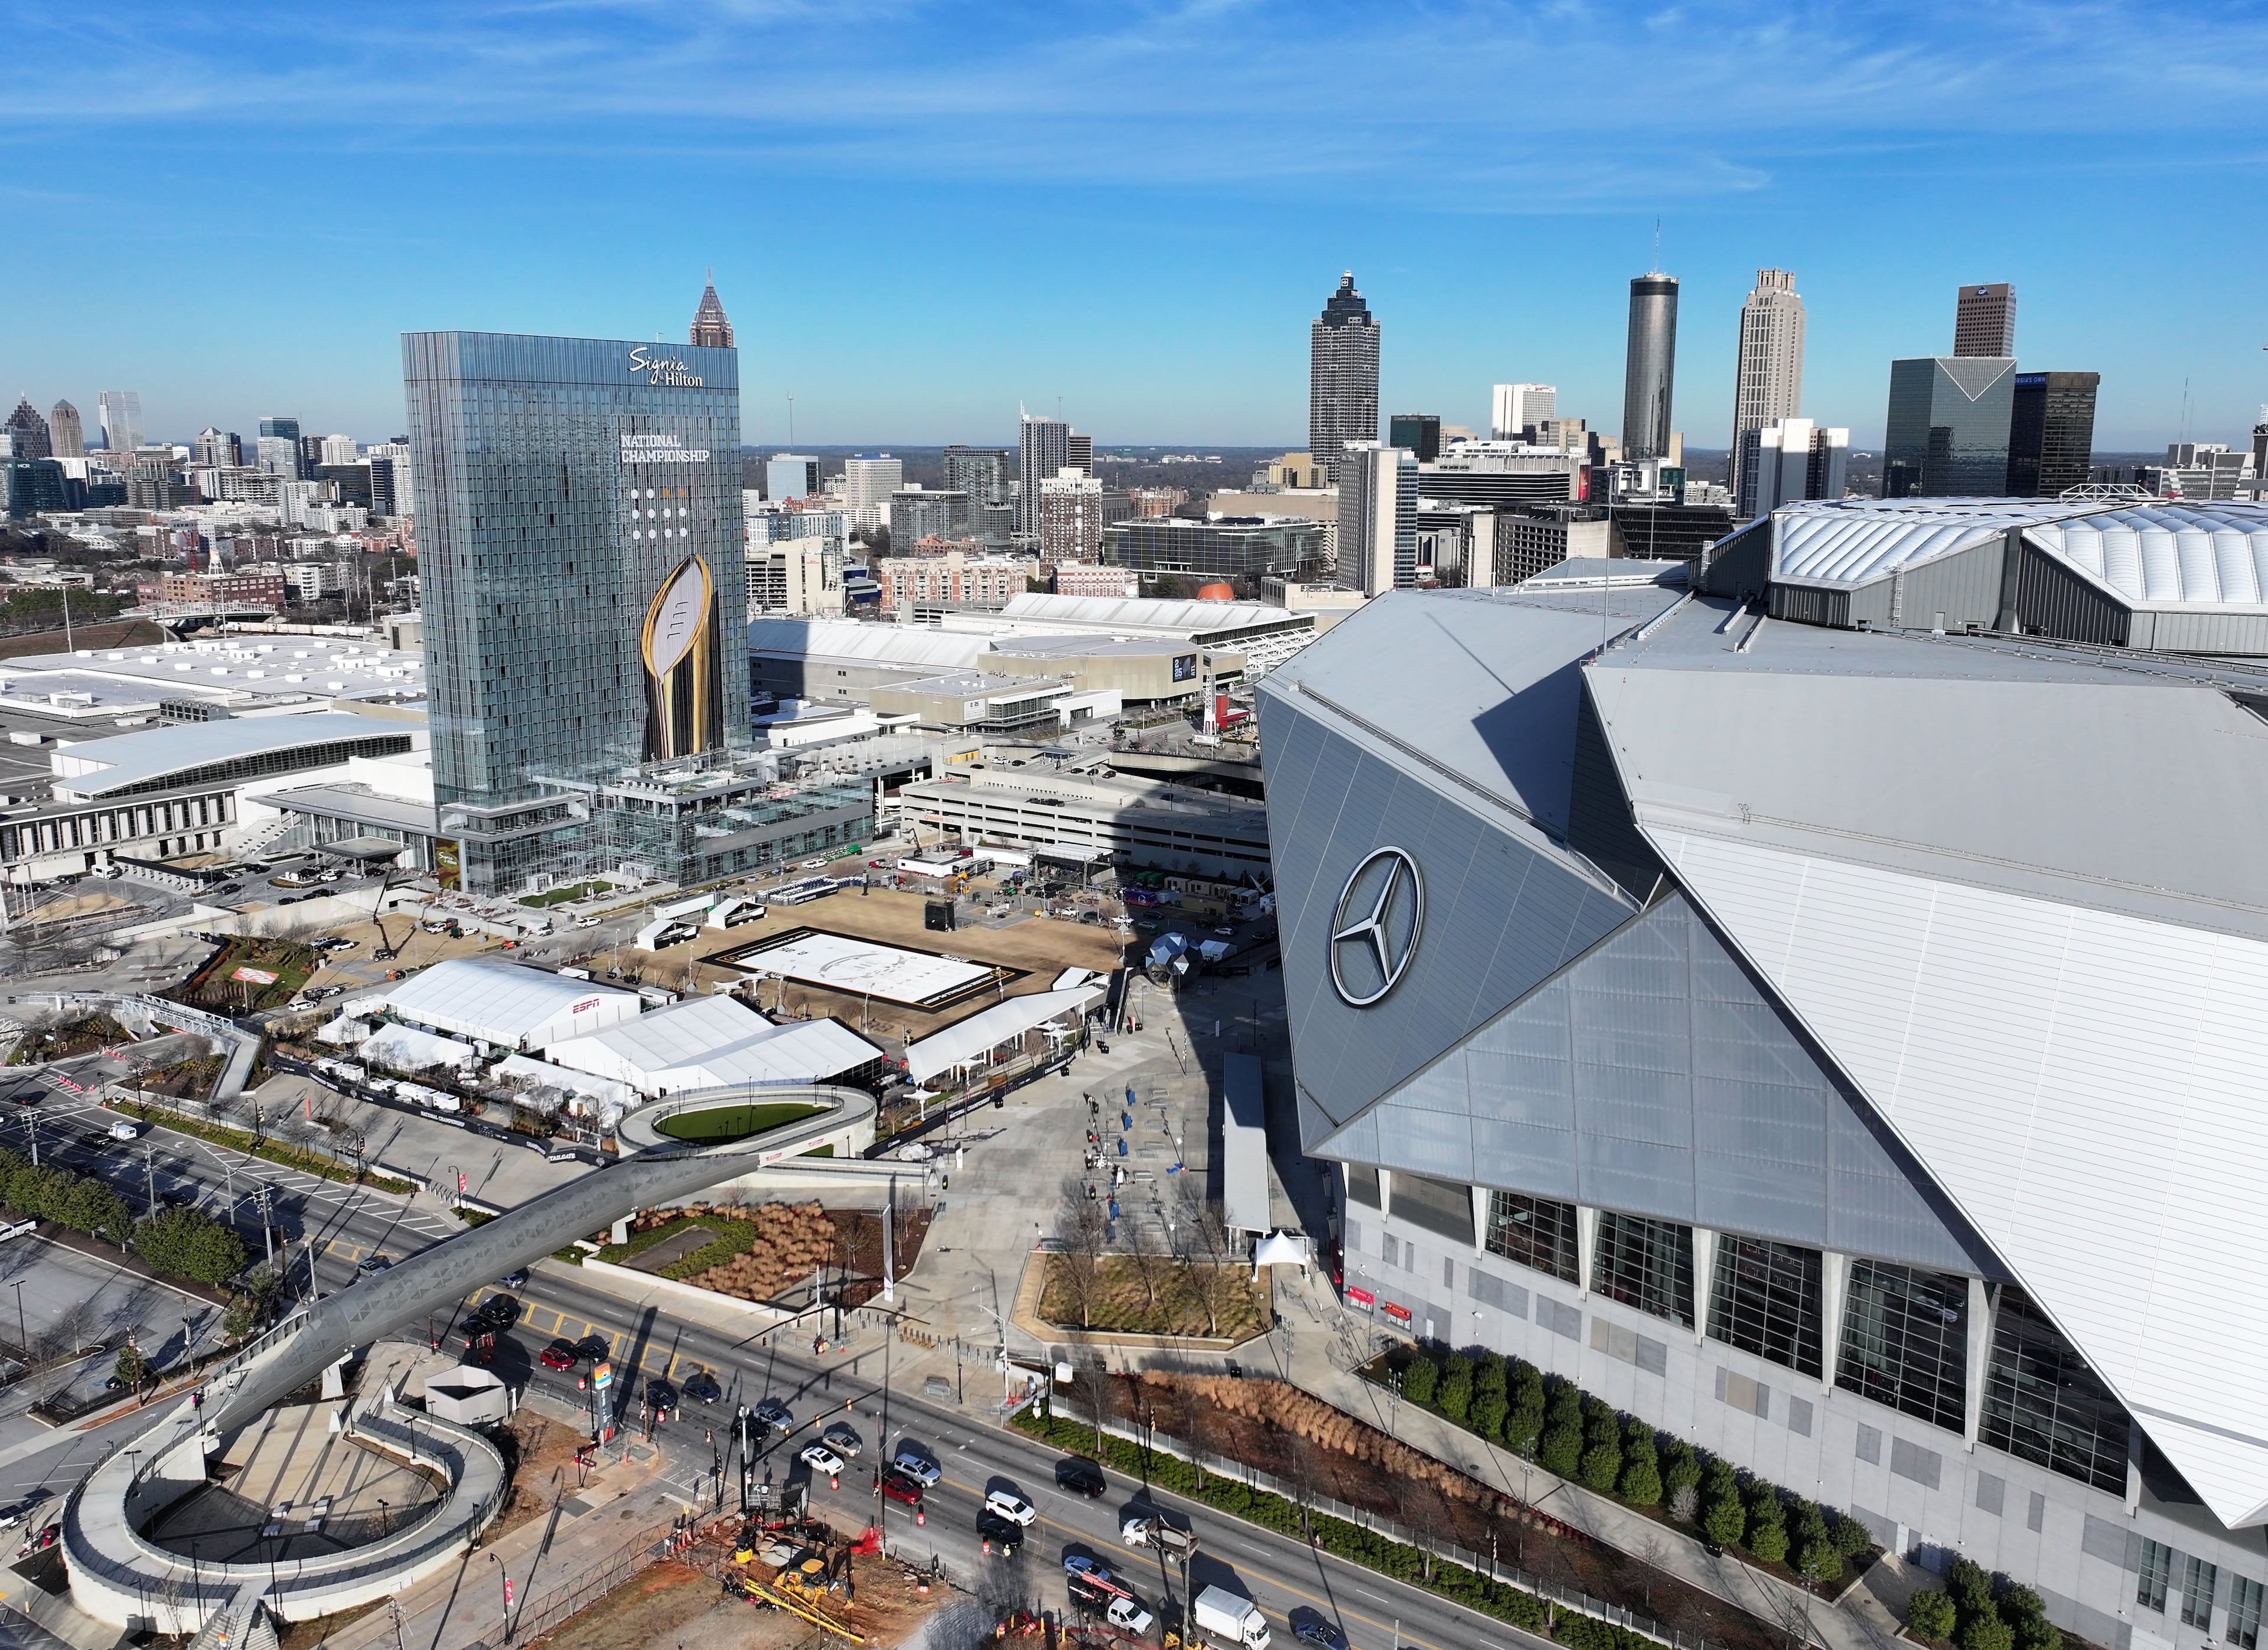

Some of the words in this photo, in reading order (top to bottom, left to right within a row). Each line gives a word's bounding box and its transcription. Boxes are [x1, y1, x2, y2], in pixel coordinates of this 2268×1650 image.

[629, 347, 689, 384] Signia
[665, 372, 703, 387] Hilton
[621, 435, 681, 448] NATIONAL
[621, 450, 709, 462] CHAMPIONSHIP
[573, 998, 599, 1014] ESPN
[421, 1111, 438, 1120] NATIONAL
[548, 1153, 576, 1162] TAILGATE
